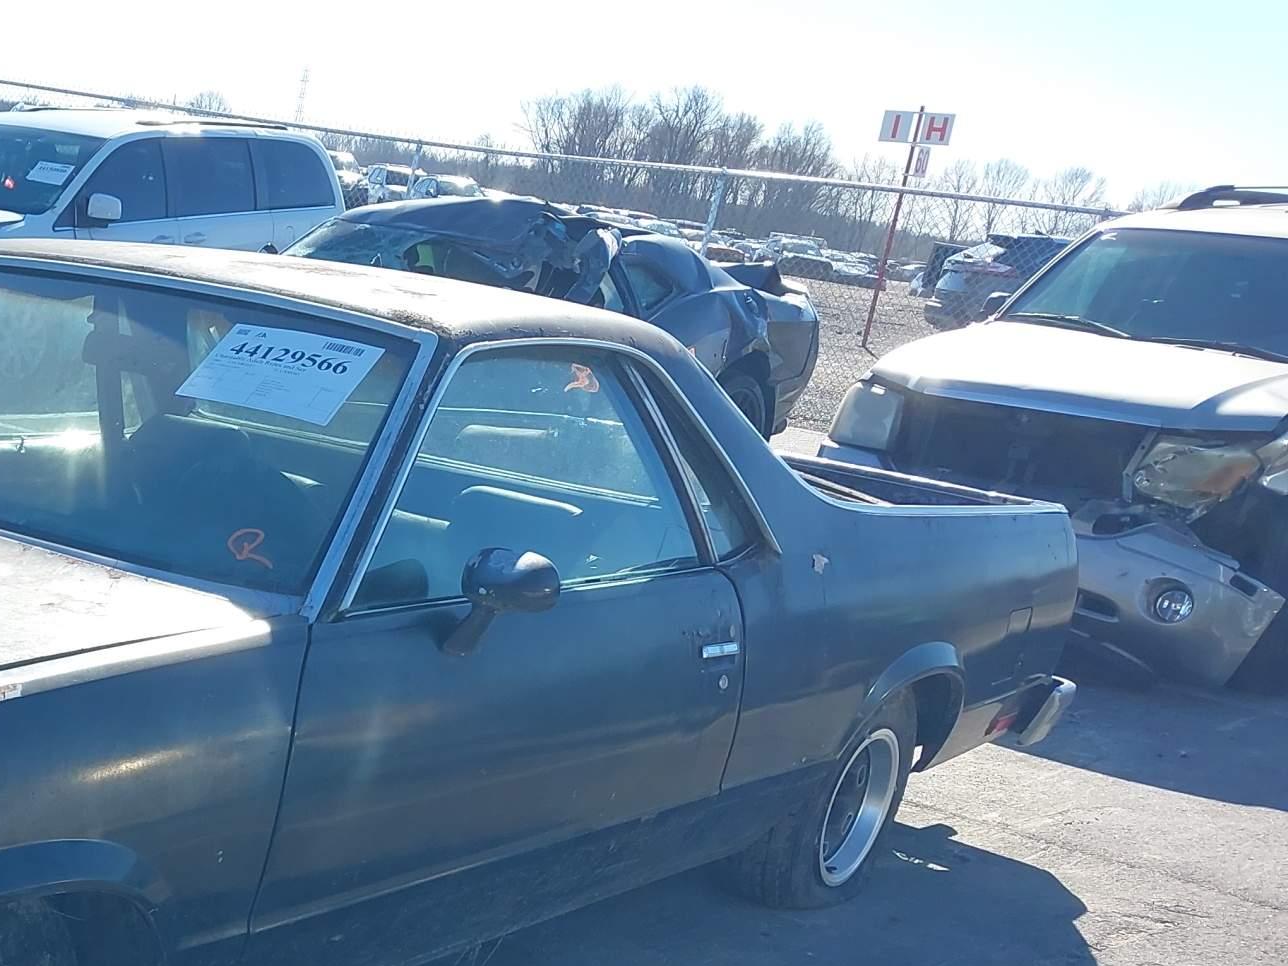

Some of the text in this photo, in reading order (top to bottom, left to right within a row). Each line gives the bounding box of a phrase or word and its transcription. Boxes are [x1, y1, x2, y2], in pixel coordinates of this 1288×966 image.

[891, 114, 901, 139] I
[925, 116, 949, 142] H
[915, 148, 929, 174] 60
[230, 341, 352, 375] 44129566
